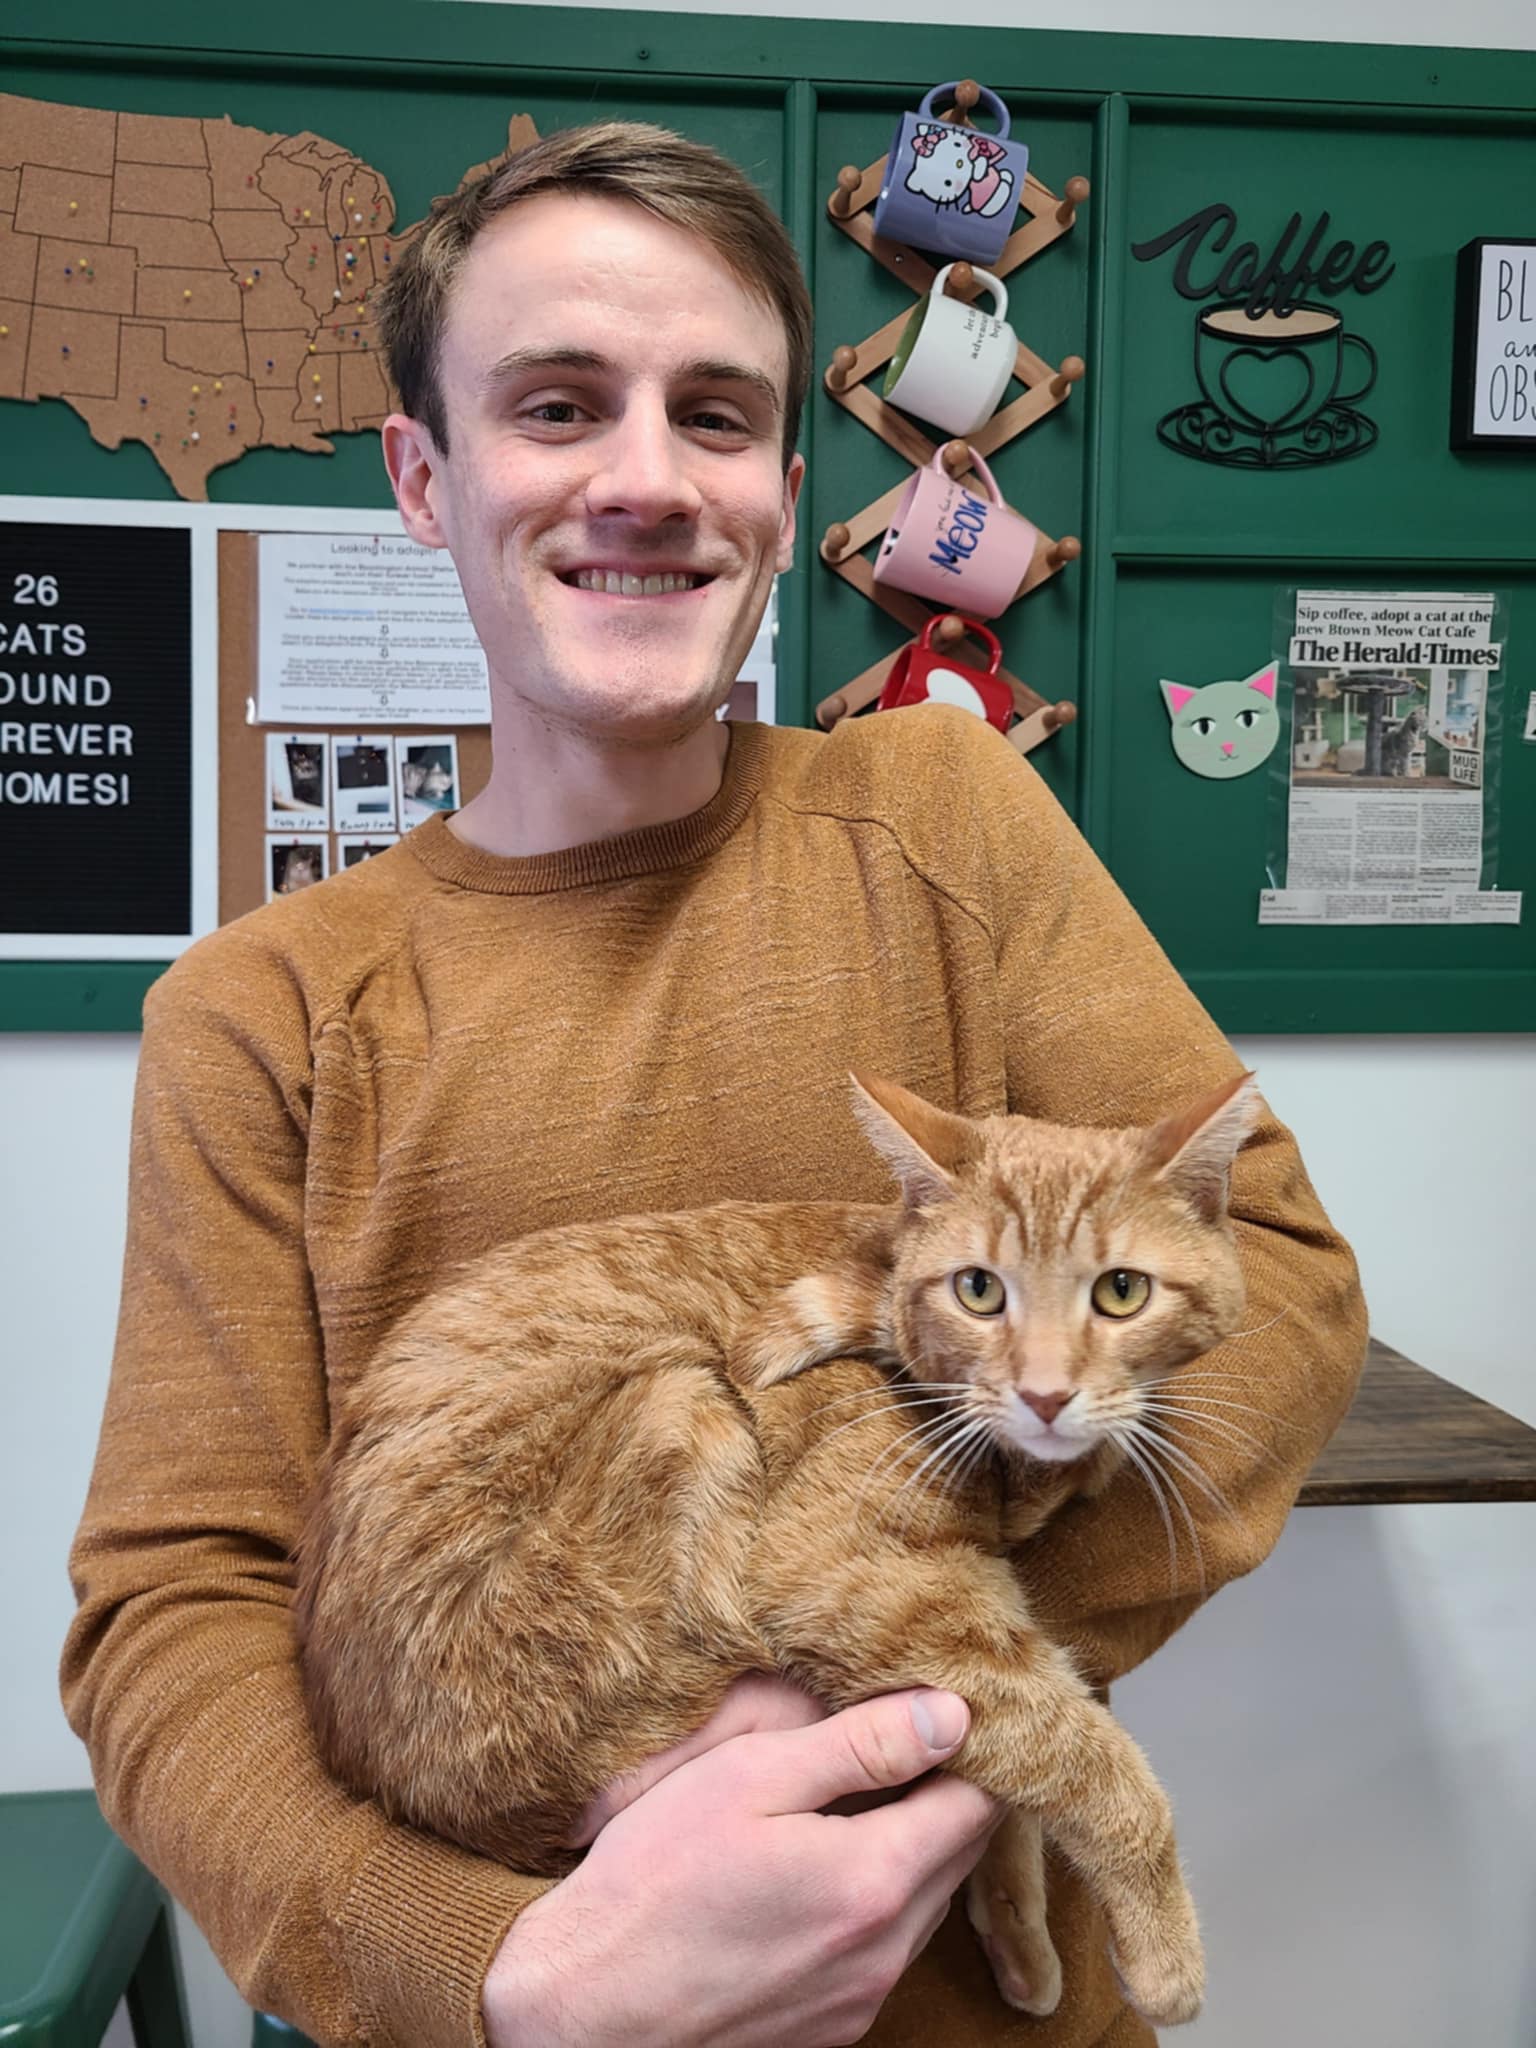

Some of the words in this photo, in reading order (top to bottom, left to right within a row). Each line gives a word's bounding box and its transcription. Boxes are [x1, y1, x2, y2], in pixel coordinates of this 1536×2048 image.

[1131, 203, 1396, 321] Coffee
[1497, 259, 1533, 323] BL
[1504, 340, 1536, 358] an
[330, 543, 379, 556] Looking
[382, 546, 393, 556] to
[13, 573, 59, 607] 26
[1298, 606, 1319, 621] Sip
[1323, 607, 1367, 622] coffee,
[1371, 608, 1409, 623] adopt
[1414, 612, 1422, 621] a
[1425, 611, 1447, 622] cat
[1451, 611, 1465, 622] at
[1469, 610, 1491, 622] the
[1297, 625, 1324, 635] new
[1328, 624, 1371, 636] Btown
[1376, 625, 1414, 637] Meow
[1418, 626, 1441, 637] Cat
[1445, 625, 1476, 638] Cafe
[1294, 640, 1339, 662] The
[1343, 641, 1499, 665] Herald-Times
[0, 671, 112, 706] OUND
[0, 721, 133, 756] REVER
[1452, 754, 1478, 769] MUG
[1453, 767, 1477, 782] LIFE
